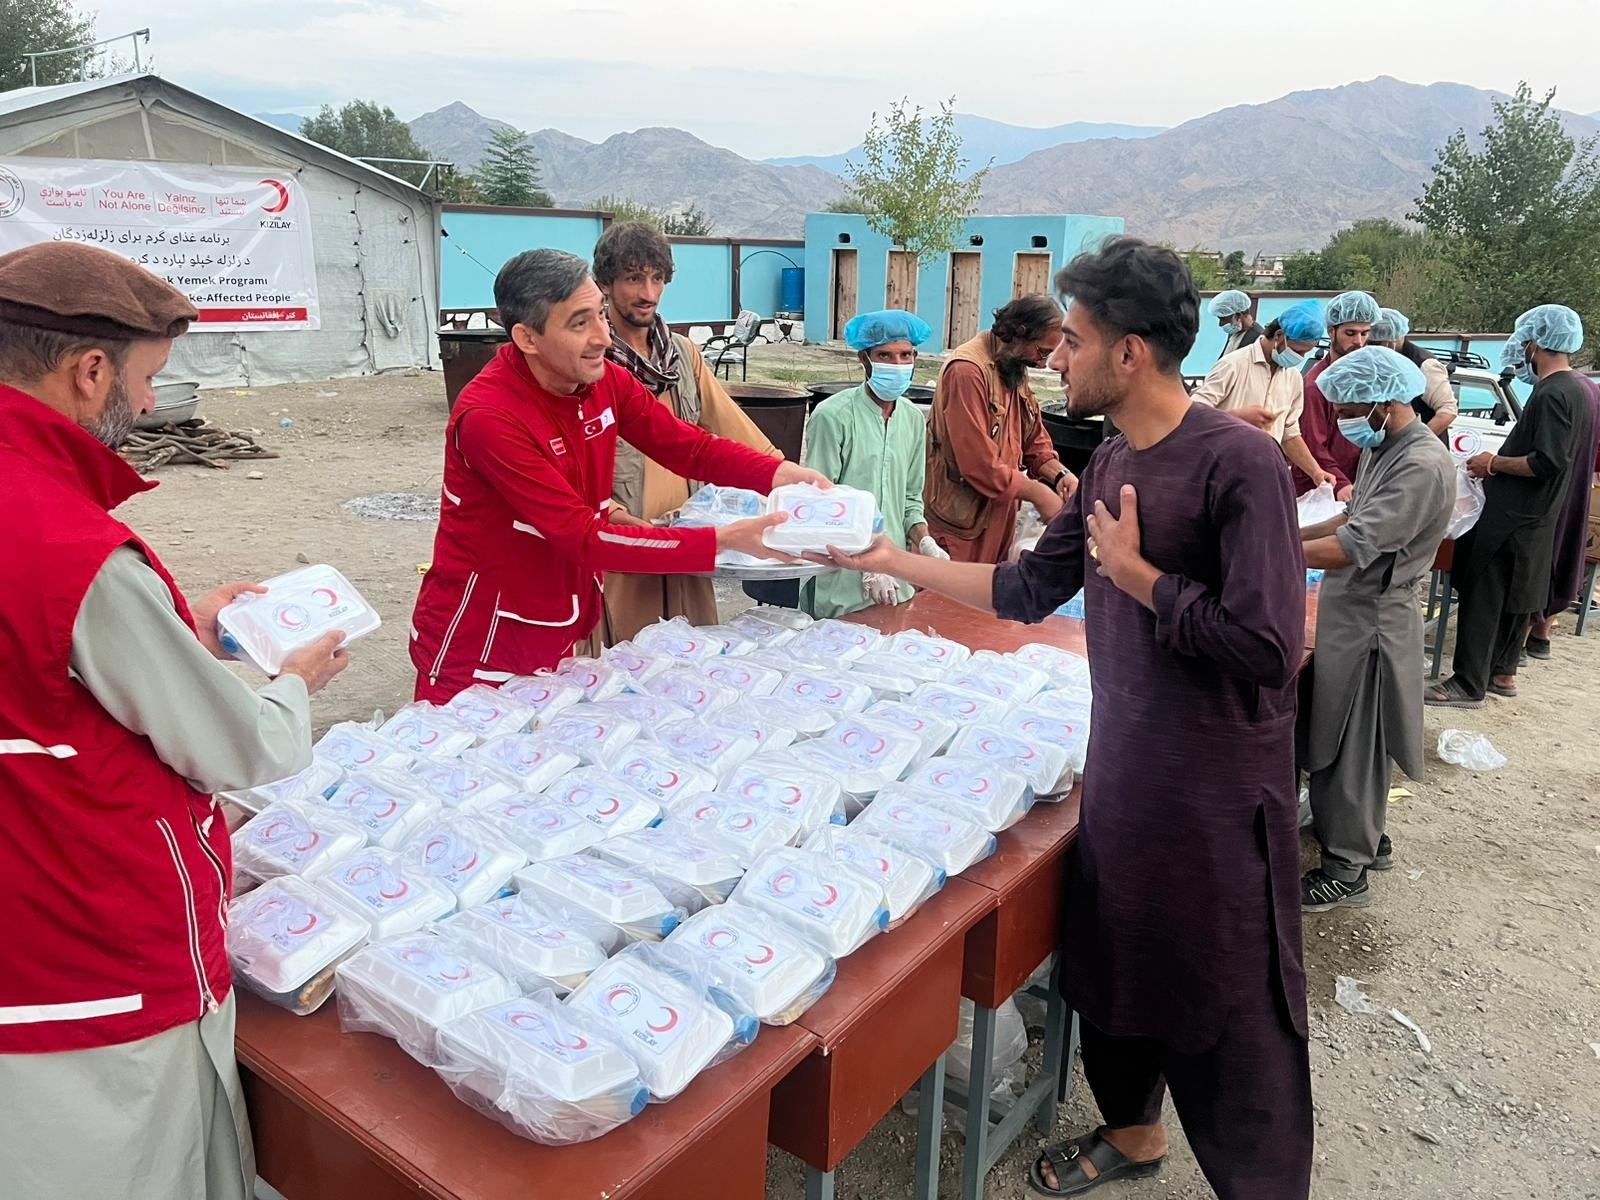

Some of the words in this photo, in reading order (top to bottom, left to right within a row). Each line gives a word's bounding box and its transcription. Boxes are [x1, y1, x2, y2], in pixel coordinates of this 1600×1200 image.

[102, 189, 123, 199] You
[127, 190, 145, 200] Are
[165, 193, 197, 203] Yalnız
[98, 200, 118, 210] Not
[121, 201, 151, 211] Alone
[158, 203, 206, 214] Değilsiniz
[260, 220, 291, 229] KIZILAY
[118, 229, 141, 244] برای
[169, 231, 197, 245] غذای
[200, 232, 230, 246] برنامه
[152, 256, 160, 264] د
[162, 253, 185, 269] لپاره
[216, 254, 242, 268] زلزله
[177, 276, 217, 285] Yemek
[188, 292, 253, 302] ke-Affected
[255, 293, 292, 304] People
